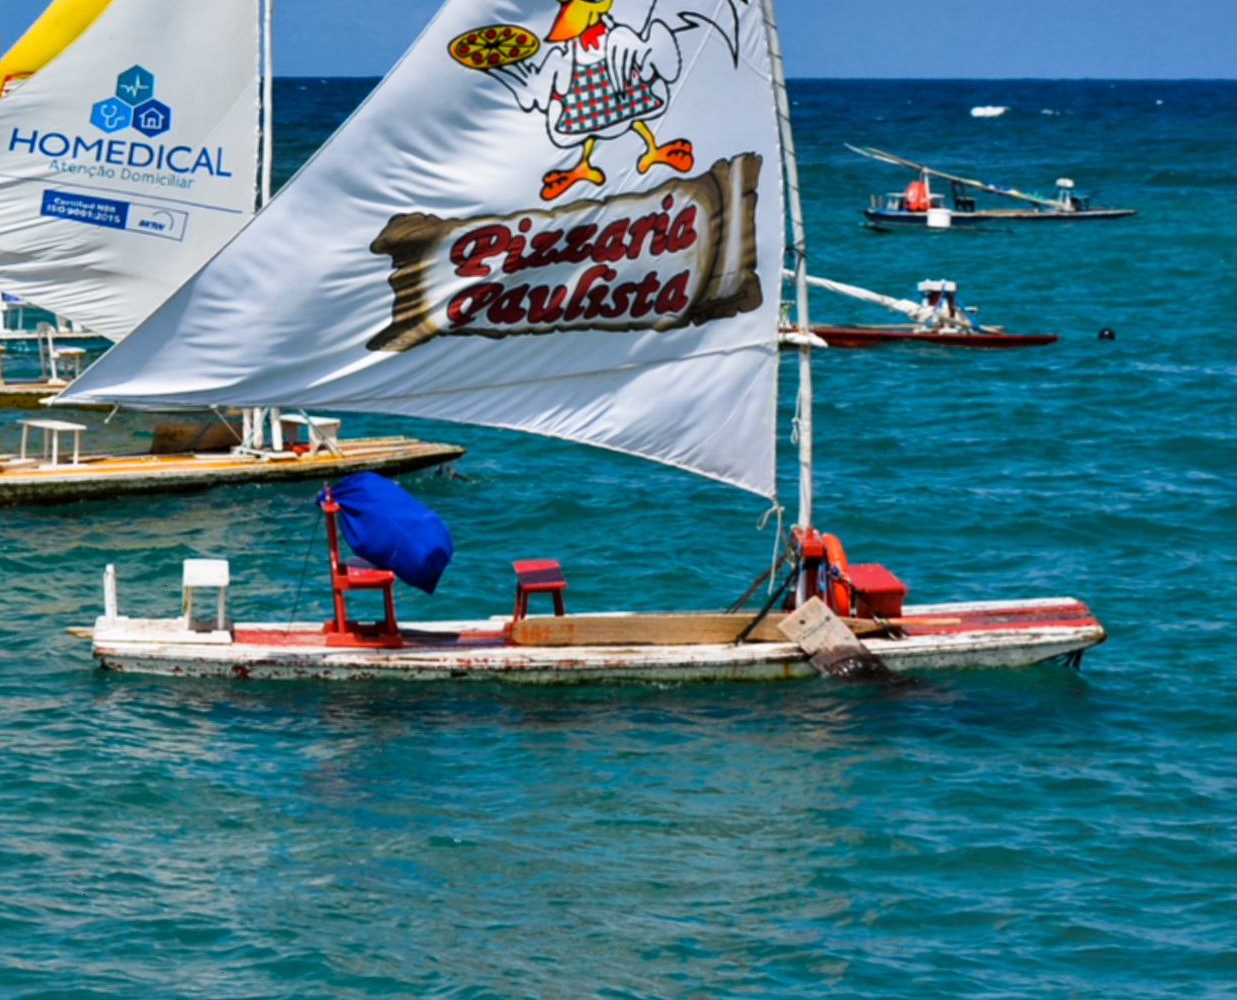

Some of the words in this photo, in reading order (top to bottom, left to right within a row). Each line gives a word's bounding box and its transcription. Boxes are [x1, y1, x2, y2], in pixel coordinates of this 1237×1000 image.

[8, 127, 232, 177] HOMEDICAL
[48, 159, 116, 179] Atenção
[120, 168, 195, 189] Domiciliar
[46, 204, 66, 214] ISO
[67, 207, 122, 223] 9001:2015
[450, 194, 697, 277] Pizzaria
[446, 263, 691, 329] Paulista
